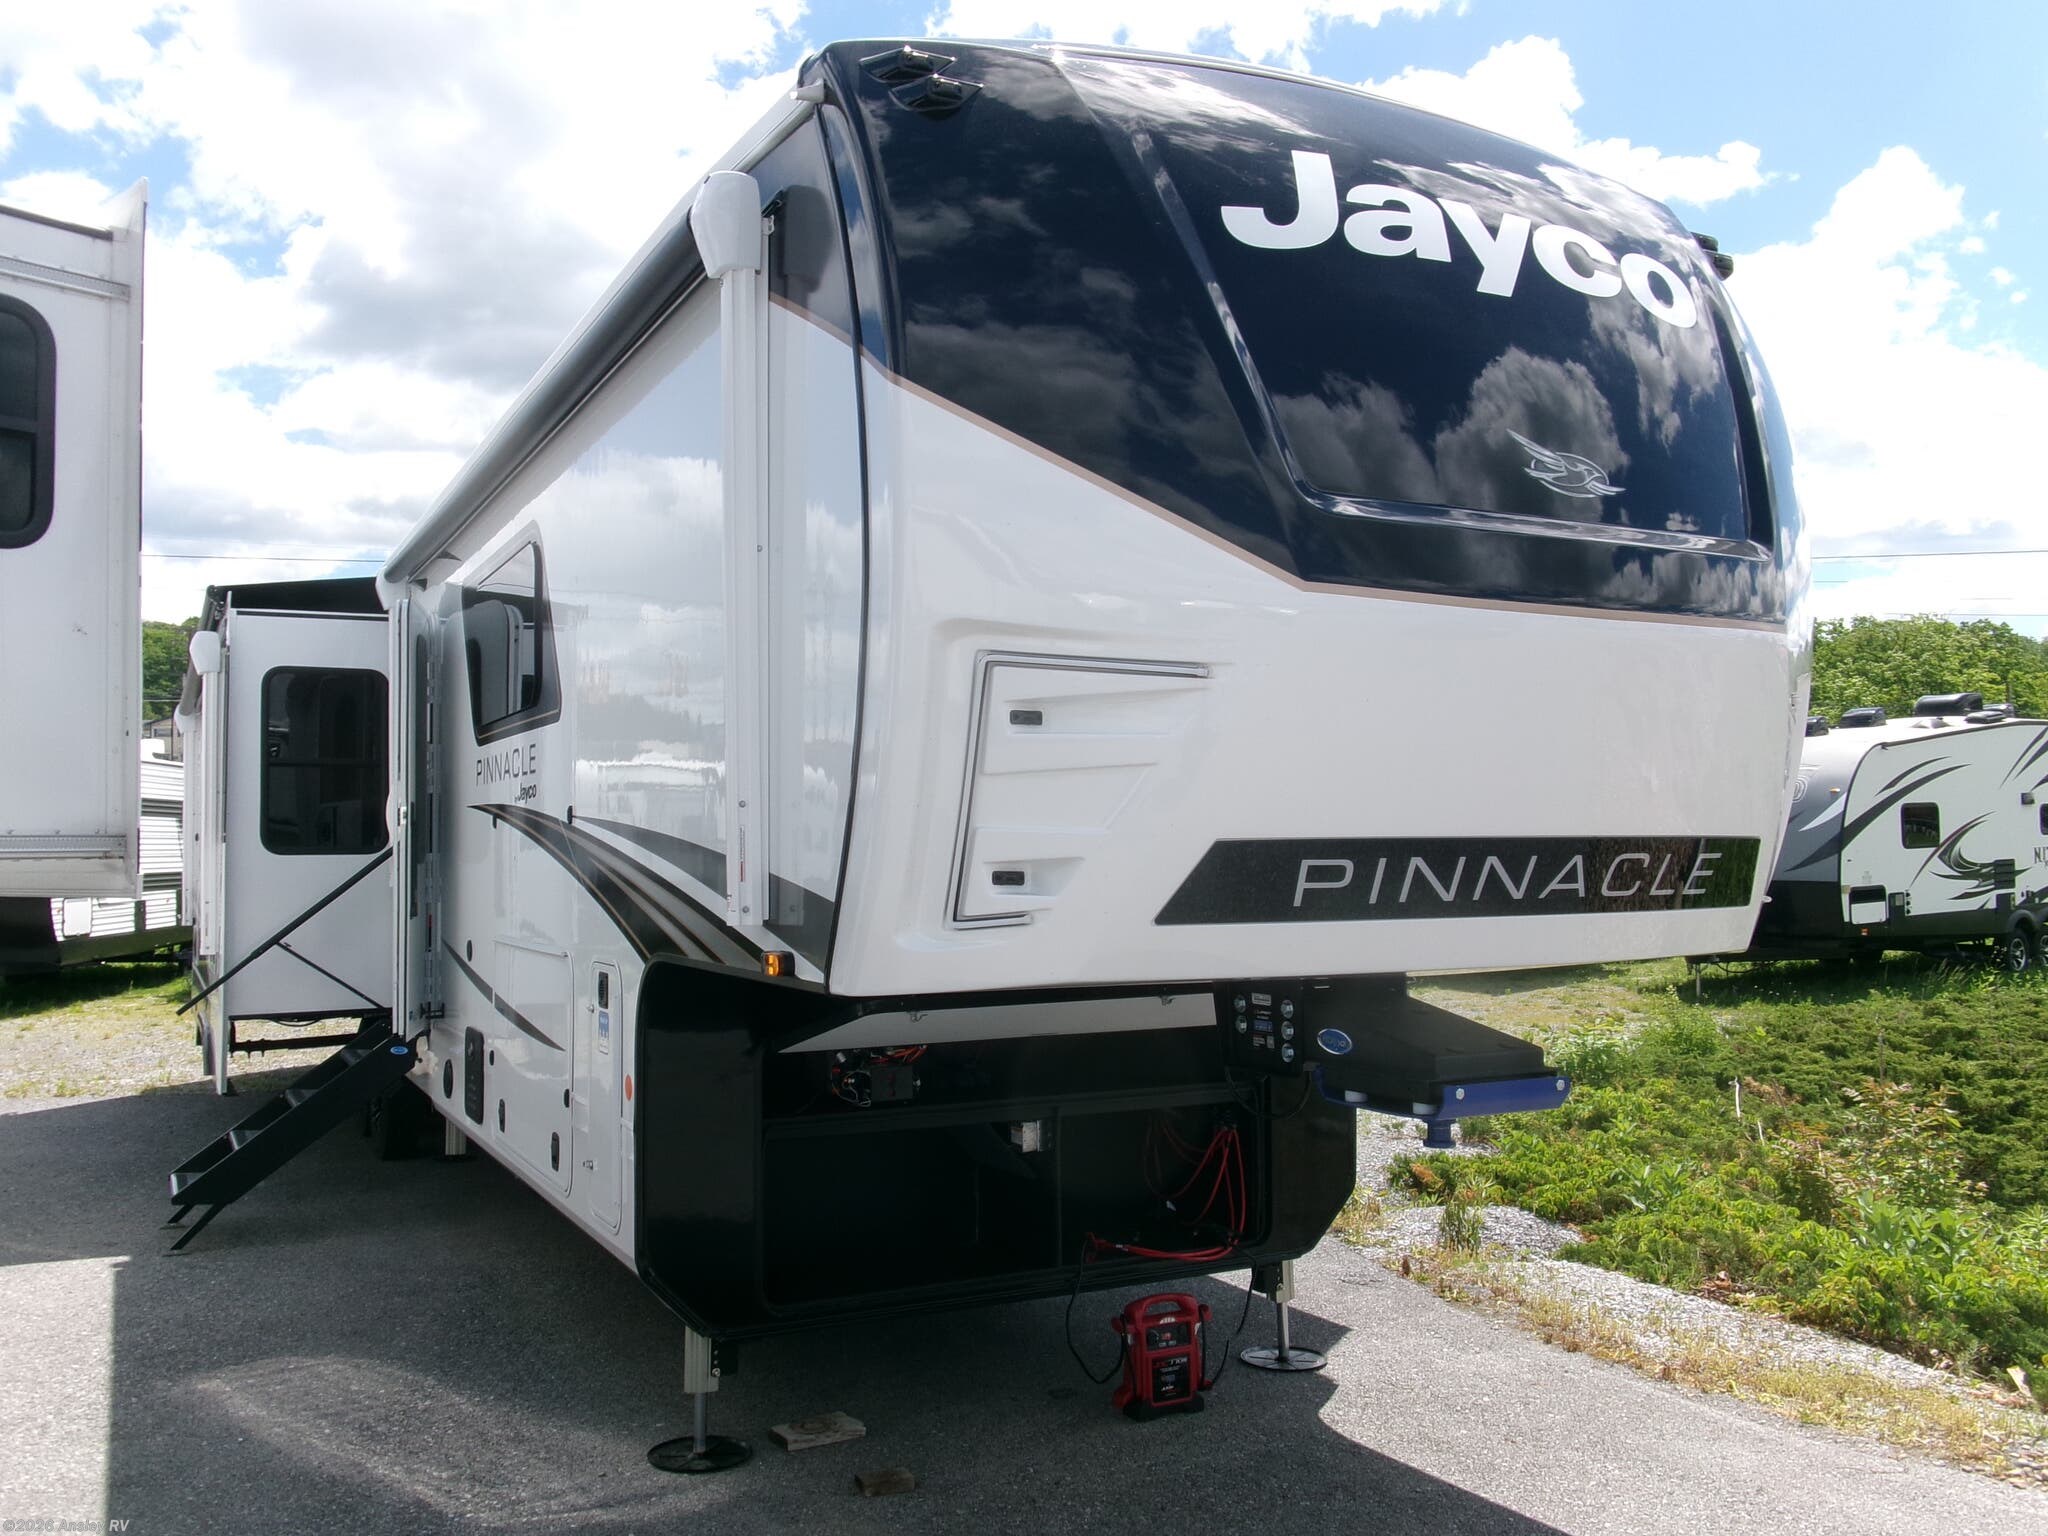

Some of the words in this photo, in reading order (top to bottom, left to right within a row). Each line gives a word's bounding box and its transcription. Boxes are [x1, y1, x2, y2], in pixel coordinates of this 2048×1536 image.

[1221, 150, 1697, 329] Jayco
[476, 743, 536, 787] PINNACLE
[517, 782, 537, 804] Jayco
[1293, 852, 1723, 907] PINNACLE
